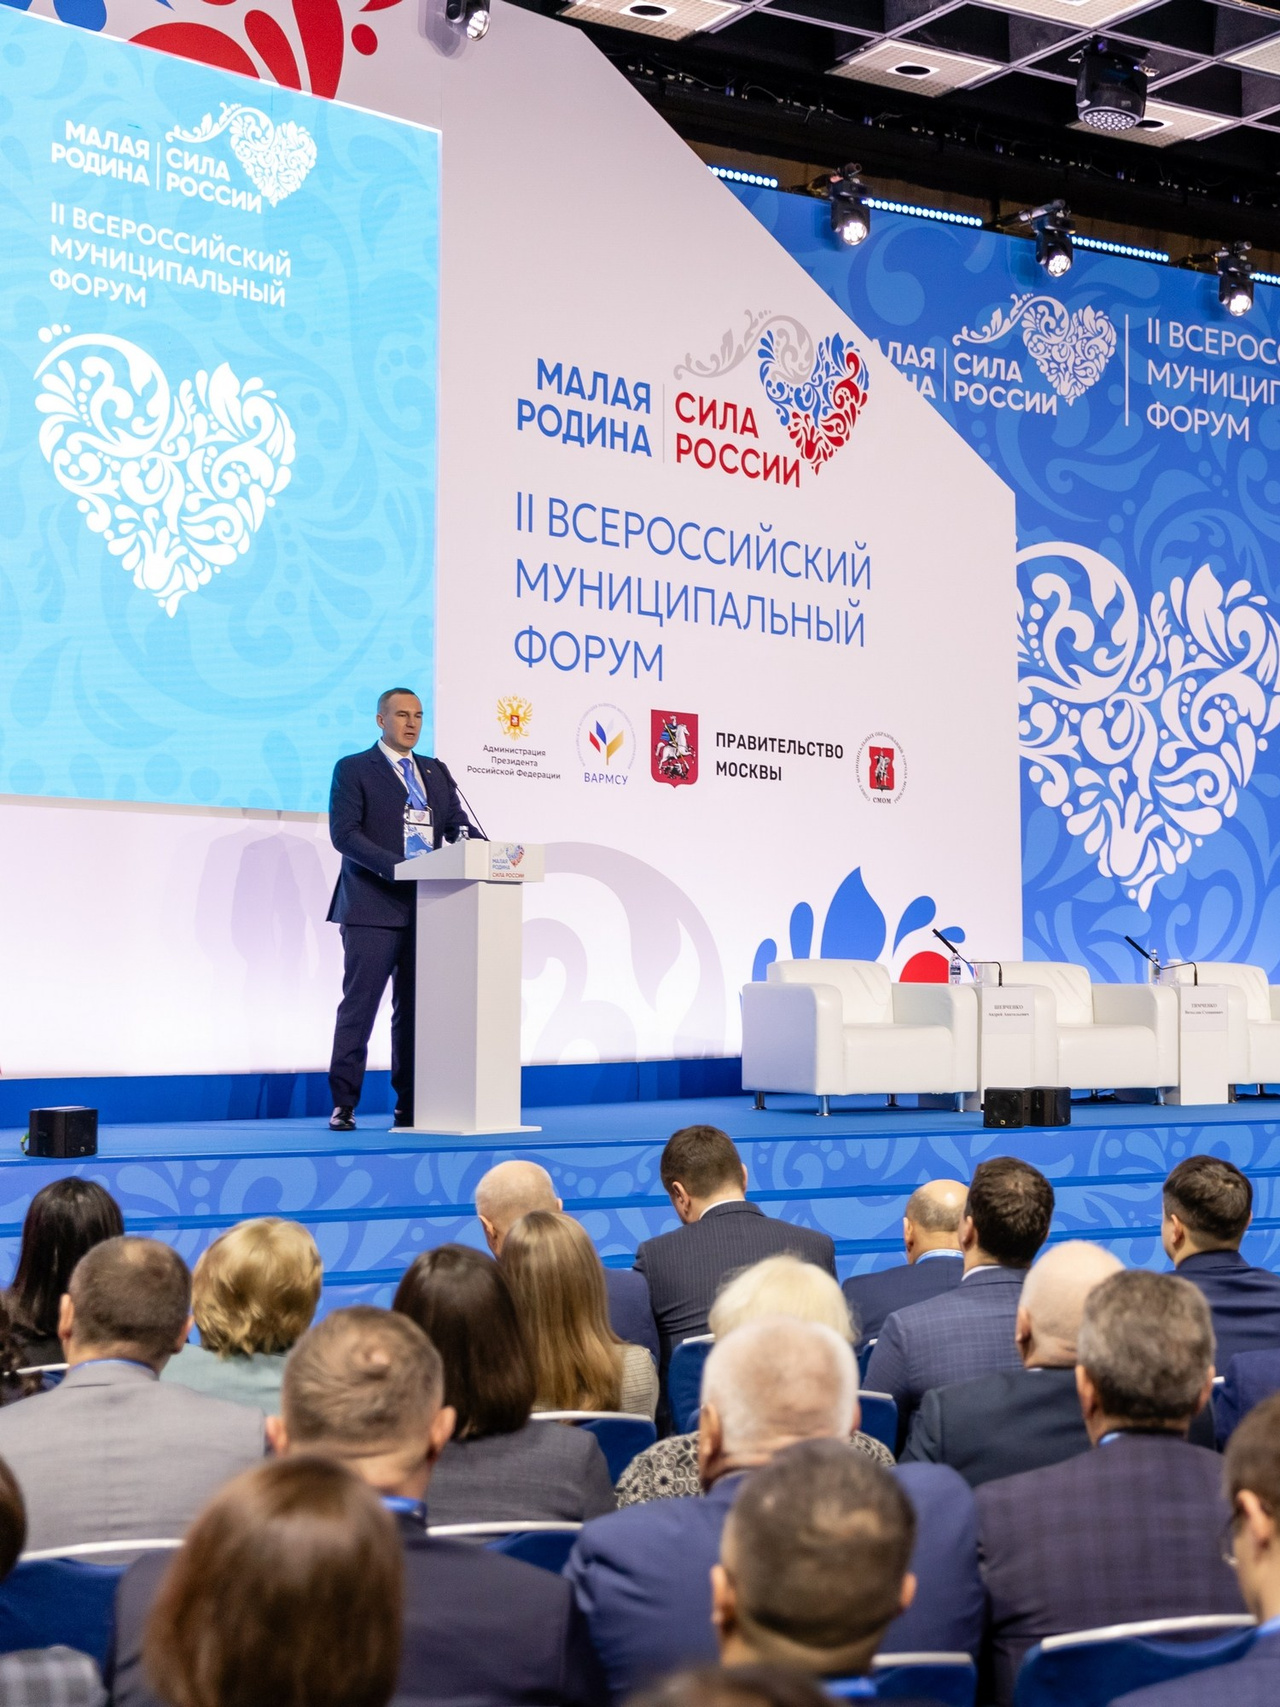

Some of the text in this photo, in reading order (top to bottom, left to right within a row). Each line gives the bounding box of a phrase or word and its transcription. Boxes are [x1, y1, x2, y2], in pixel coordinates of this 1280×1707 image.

[65, 120, 149, 161] МАЛАЯ
[51, 143, 150, 186] РОДИНА
[166, 147, 230, 181] СИЛА
[166, 171, 262, 214] РОССИИ
[51, 202, 291, 278] II ВСЕРОССИЙСКИЙ
[49, 268, 146, 308] ФОРУМ
[50, 235, 285, 308] МУНИЦИПАЛЬНЫЙ
[1147, 317, 1161, 345] II
[537, 357, 651, 415] МАЛАЯ
[953, 352, 1023, 383] СИЛА
[675, 391, 759, 439] СИЛА
[954, 380, 1057, 416] РОССИИ
[517, 398, 652, 458] РОДИНА
[1146, 402, 1250, 442] ФОРУМ
[676, 432, 800, 488] РОССИИ
[517, 491, 871, 590] II ВСЕРОССИЙСКИЙ
[516, 558, 865, 648] МУНИЦИПАЛЬНЫЙ
[514, 625, 663, 682] ФОРУМ
[483, 744, 546, 757] Администрация
[491, 756, 538, 768] Президента
[715, 731, 844, 759] ПРАВИТЕЛЬСТВО
[467, 765, 561, 780] Российской Федерации
[584, 772, 629, 785] ВАРМСУ
[715, 760, 782, 781] МОСКВЫ
